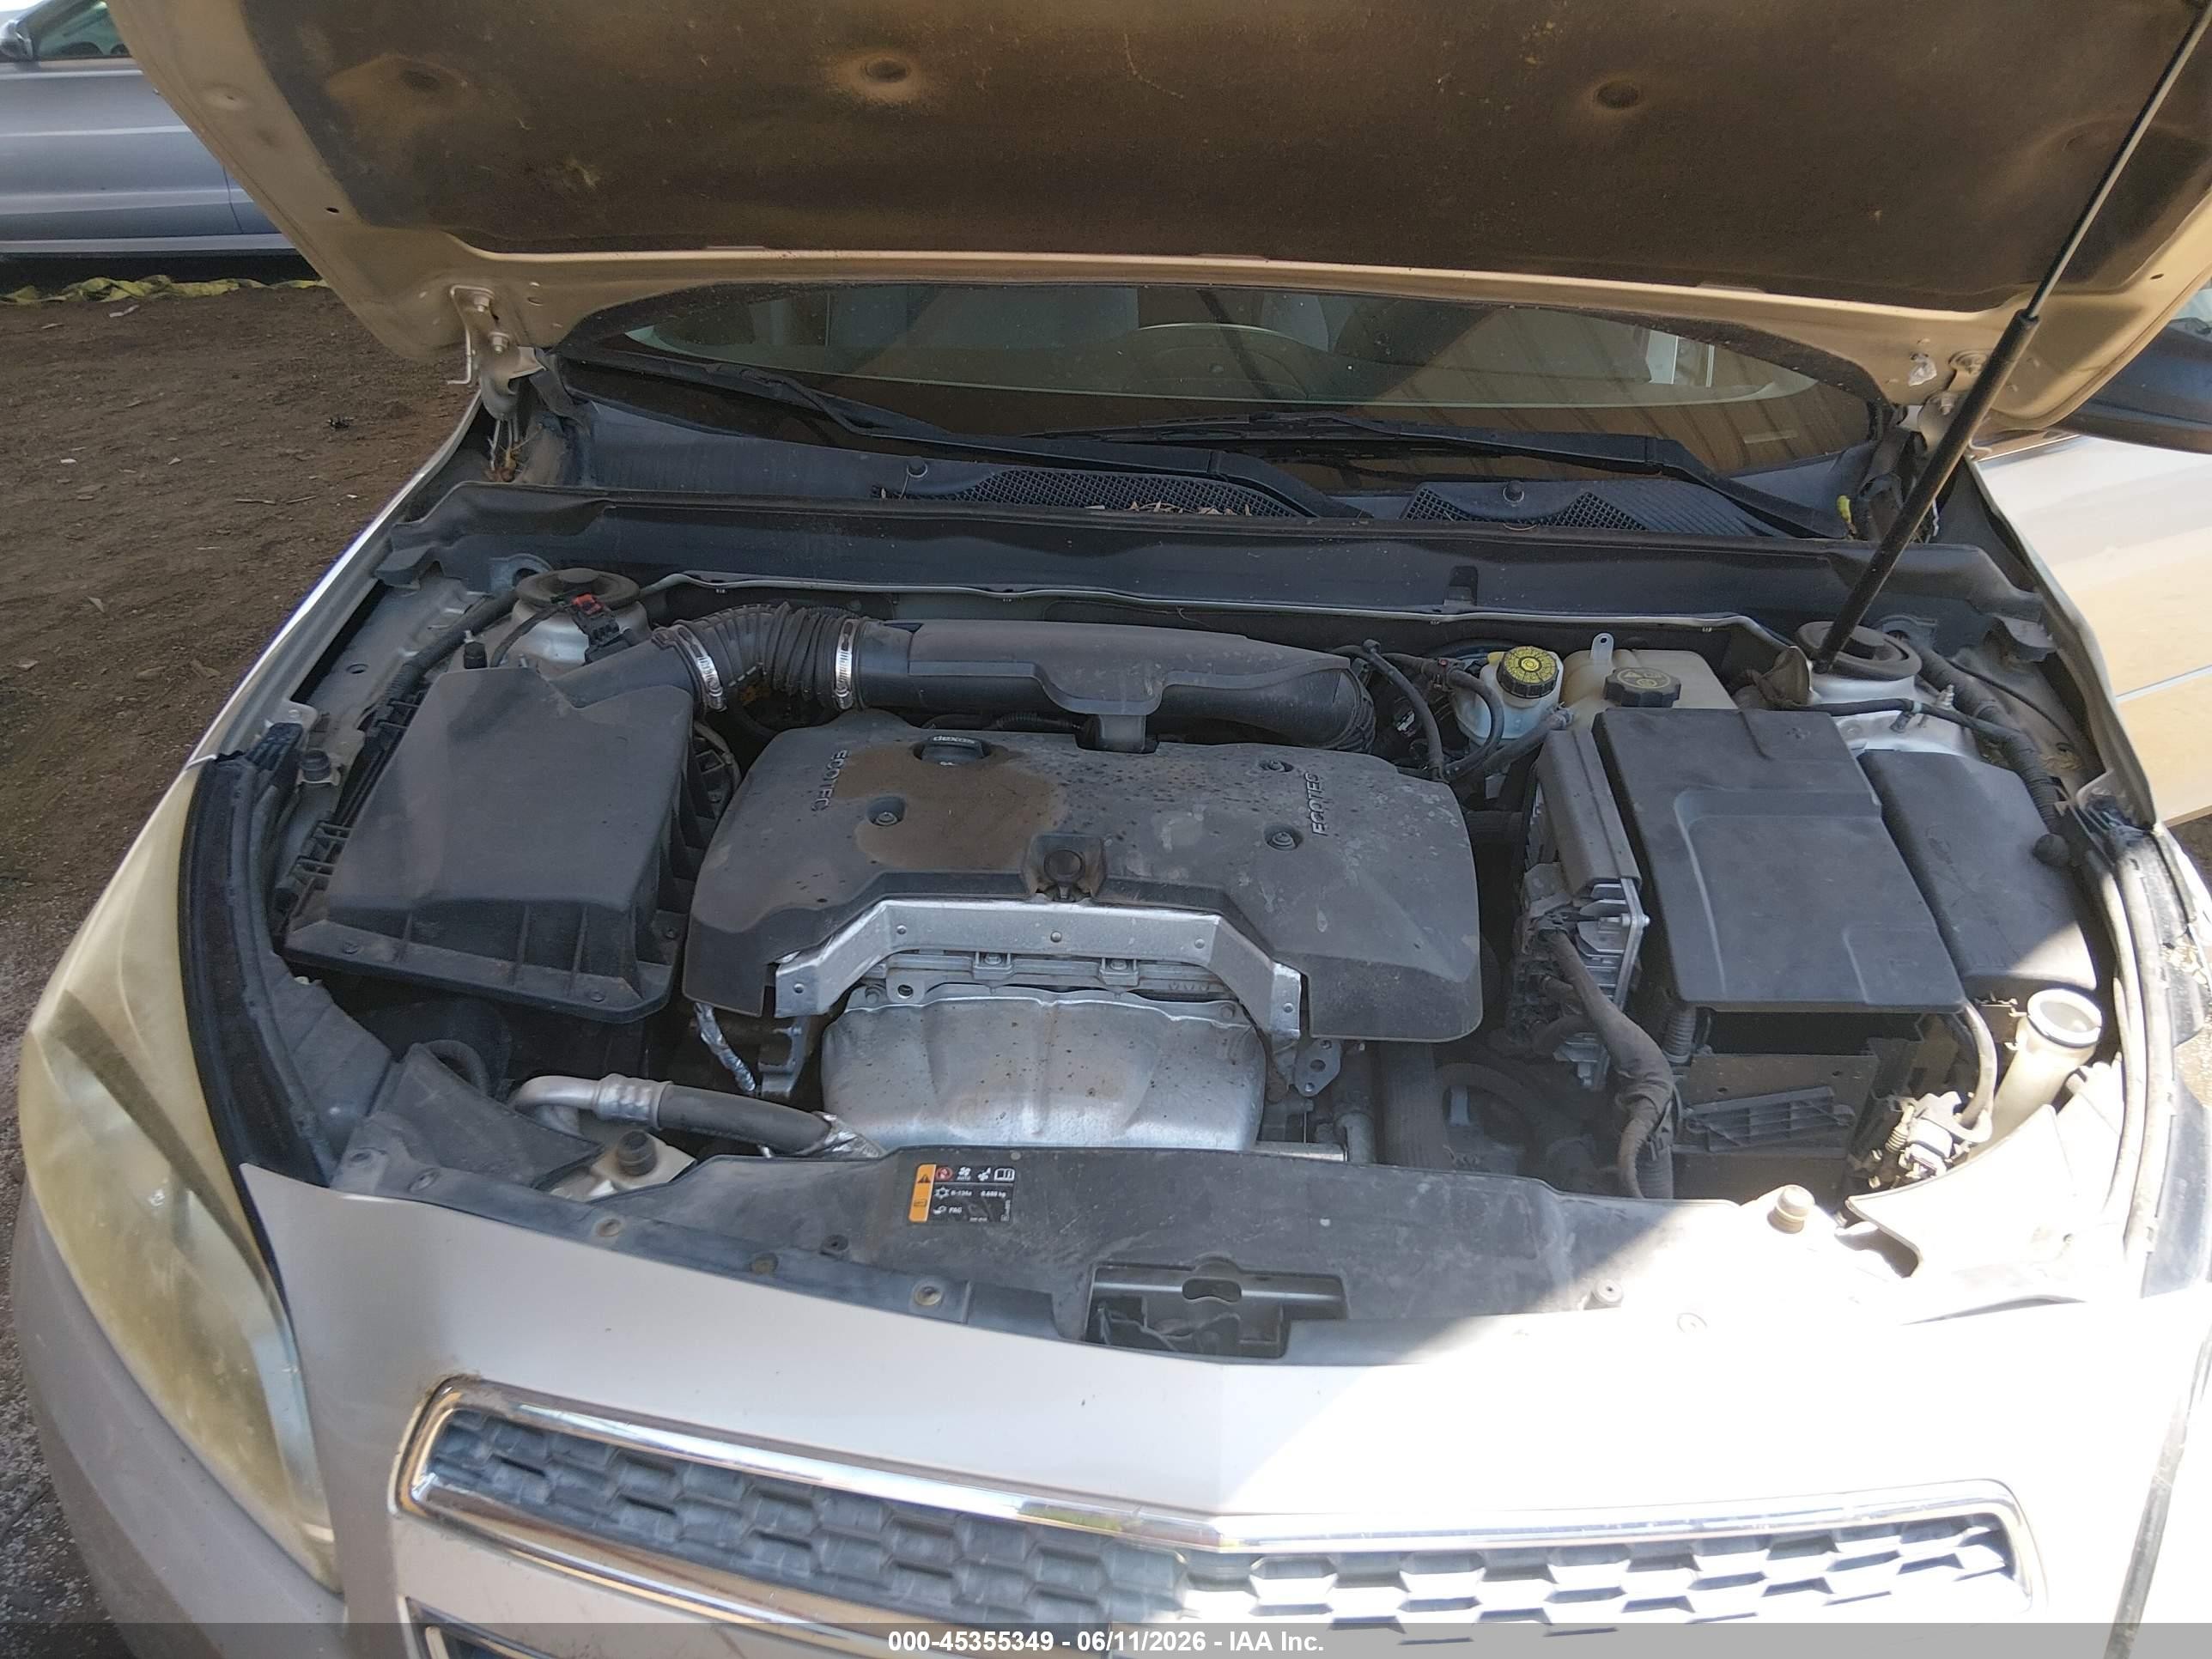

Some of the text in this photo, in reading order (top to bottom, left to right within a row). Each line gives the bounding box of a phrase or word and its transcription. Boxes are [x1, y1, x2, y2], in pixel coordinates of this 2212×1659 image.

[933, 736, 975, 744] dexos
[811, 749, 848, 811] ECOTEC
[1304, 772, 1328, 836] ECOTEC
